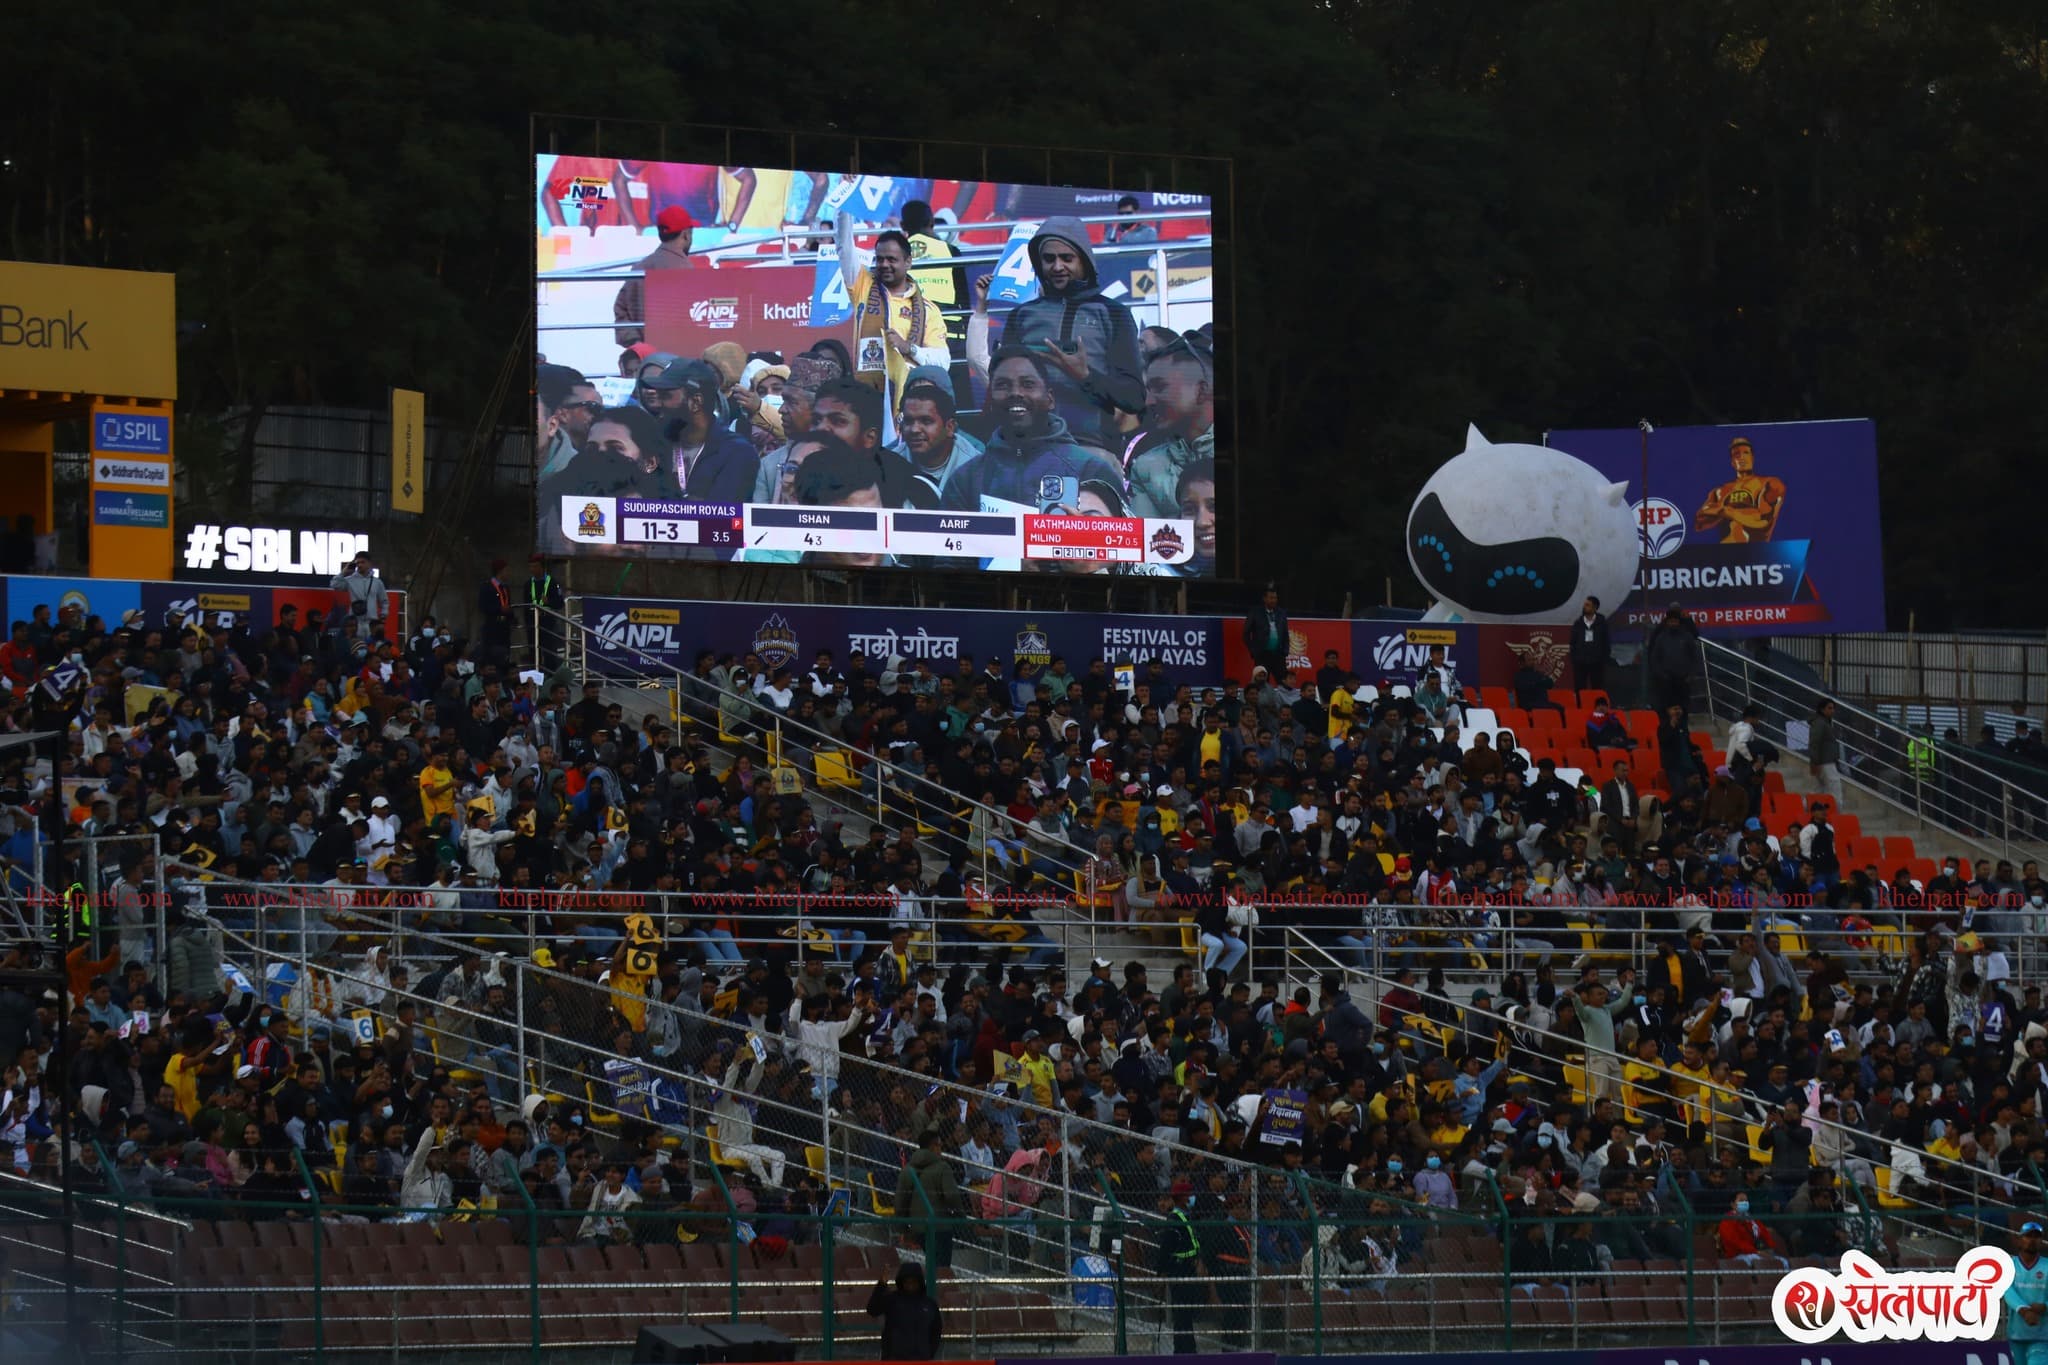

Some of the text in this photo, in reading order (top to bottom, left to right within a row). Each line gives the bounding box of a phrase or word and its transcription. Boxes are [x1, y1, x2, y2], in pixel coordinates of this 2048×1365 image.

[572, 185, 608, 200] NPL
[997, 243, 1036, 287] 4
[820, 267, 851, 311] 4
[707, 306, 739, 319] NPL
[0, 304, 90, 351] Bank
[123, 421, 162, 442] SPIL
[111, 464, 165, 482] Siddhartha Capital
[1730, 491, 1748, 504] HP
[623, 501, 737, 517] SUDURPASCHIM ROYALS
[1638, 507, 1672, 525] HP
[798, 513, 831, 525] ISHAN
[938, 518, 971, 529] AARIF
[1033, 518, 1134, 533] KATHMANDU GORKHAS
[641, 521, 679, 541] 11-3
[712, 530, 730, 543] 3.5
[803, 532, 823, 547] 4 3
[1029, 532, 1062, 544] MILIND
[1104, 535, 1123, 546] 0-7
[944, 537, 963, 551] 4 6
[1631, 563, 1784, 591] UBRICANTS
[1688, 610, 1708, 624] TO
[1715, 607, 1787, 622] PERFORM
[626, 623, 681, 649] NPL
[902, 626, 960, 660] गौरव
[1103, 627, 1207, 648] FESTIVAL OF
[53, 669, 79, 691] 4
[1118, 671, 1131, 687] 4
[358, 1018, 373, 1039] 6
[1985, 1006, 2003, 1033] 4
